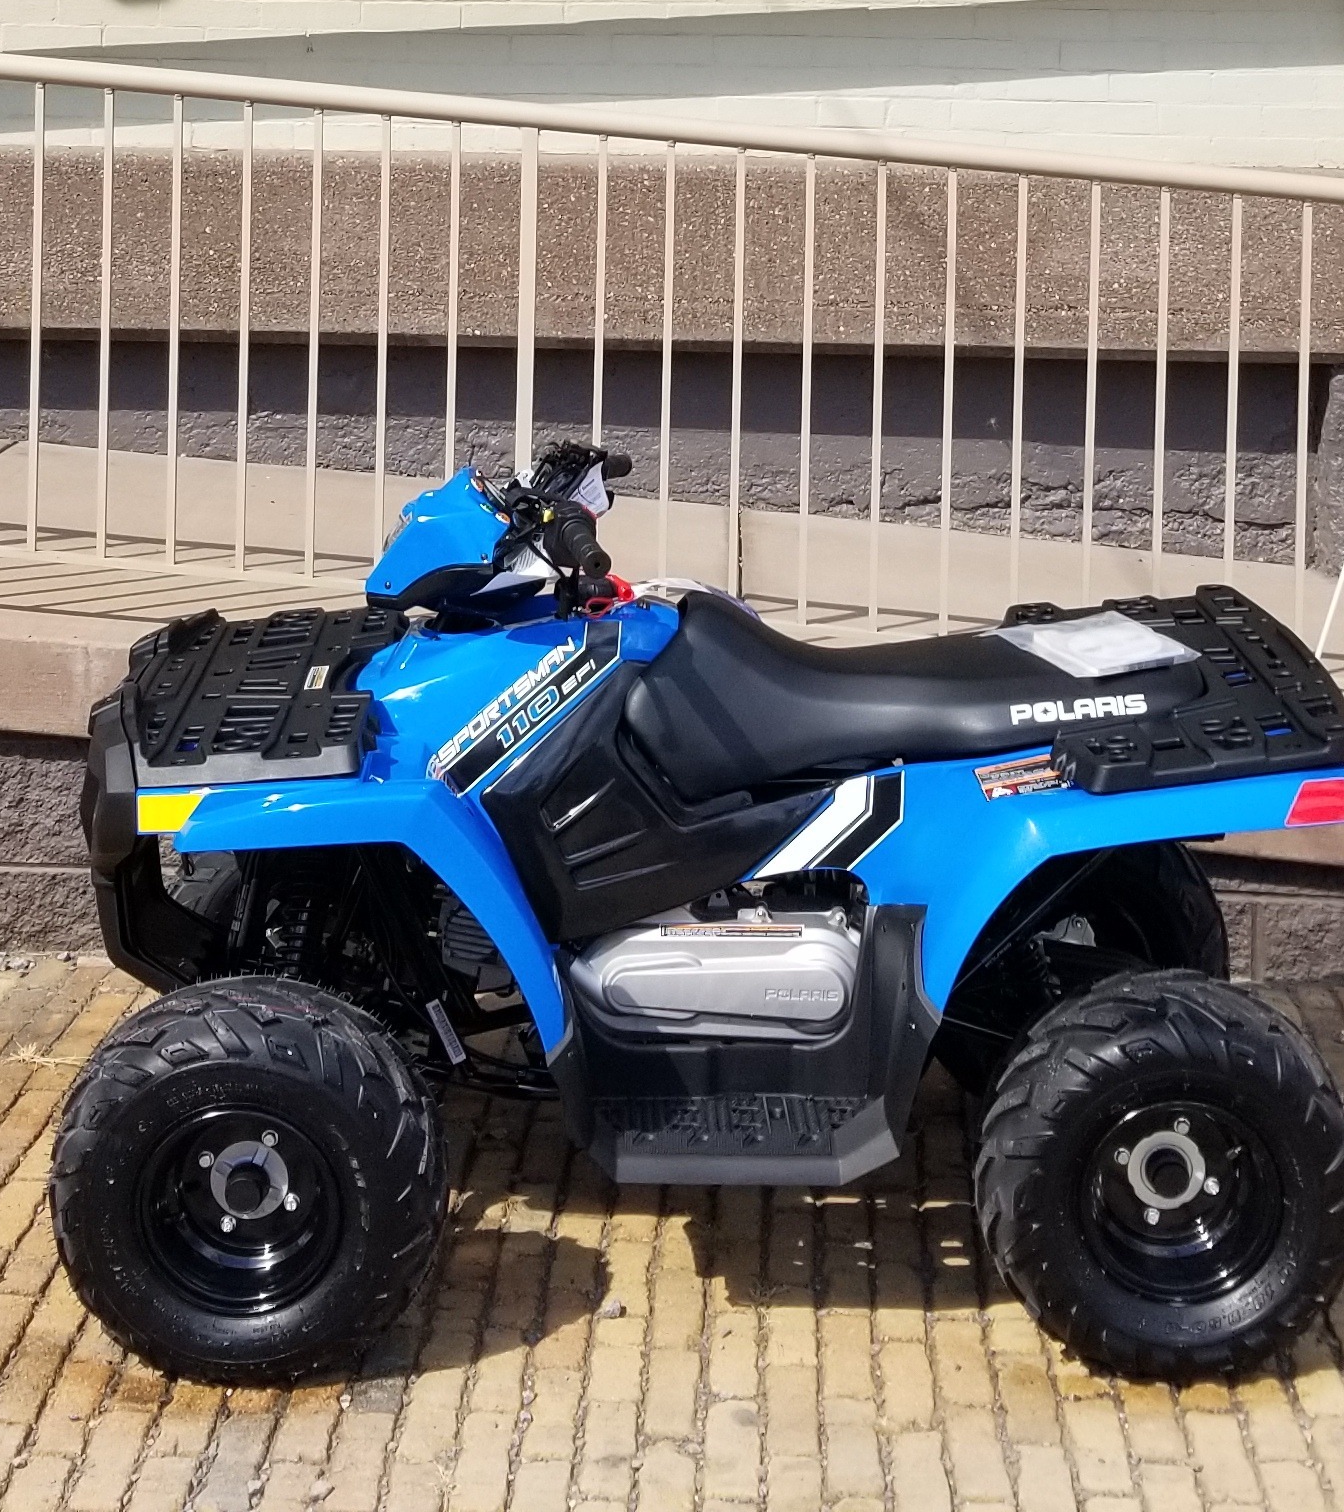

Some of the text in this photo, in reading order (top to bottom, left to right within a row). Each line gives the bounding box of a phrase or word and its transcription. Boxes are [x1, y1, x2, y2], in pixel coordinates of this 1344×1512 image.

[437, 636, 577, 764] SPORTSMAN
[495, 660, 596, 749] 110 EFI
[1010, 693, 1147, 725] POLARIS
[765, 988, 838, 1001] POLARIS
